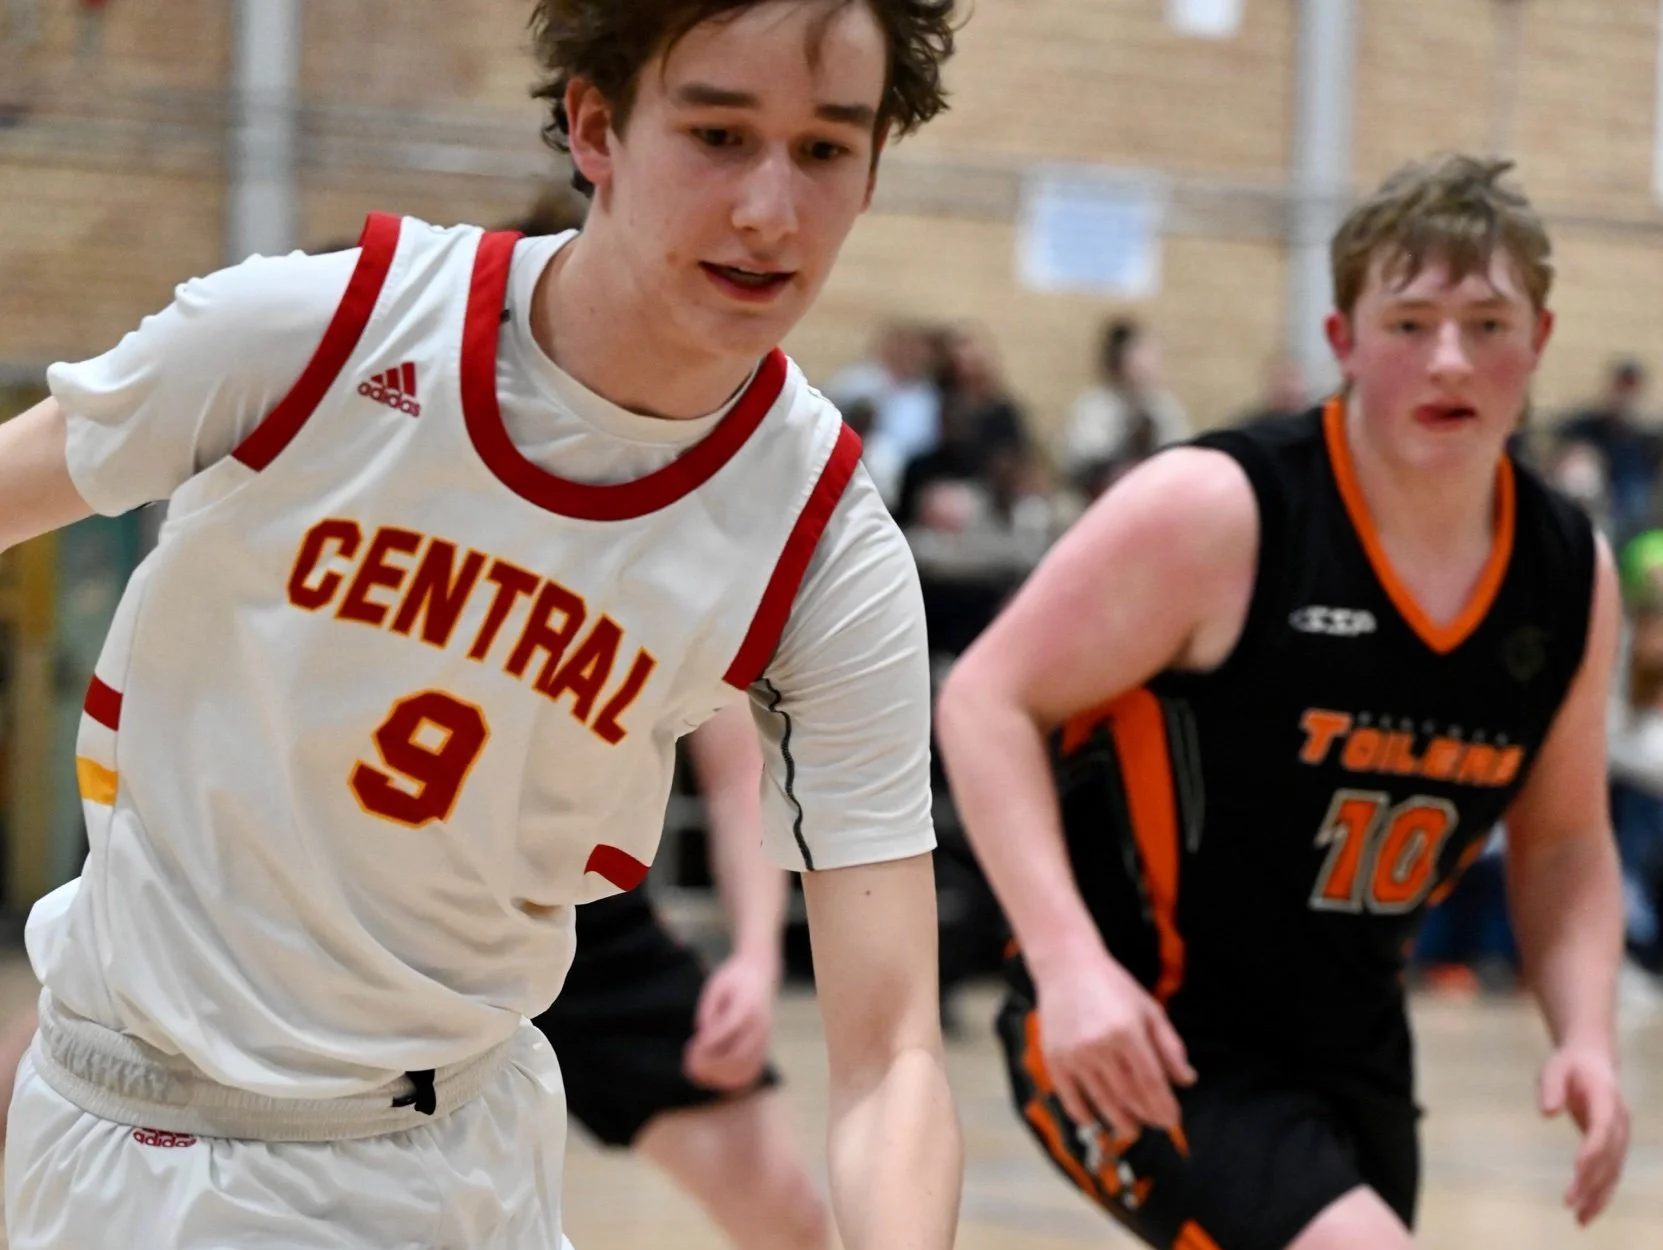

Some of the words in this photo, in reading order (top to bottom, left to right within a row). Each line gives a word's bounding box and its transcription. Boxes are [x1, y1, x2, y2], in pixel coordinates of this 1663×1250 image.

[357, 382, 421, 417] adidas
[287, 518, 657, 746] CENTRAL
[347, 689, 491, 829] 9
[1308, 787, 1459, 914] 10
